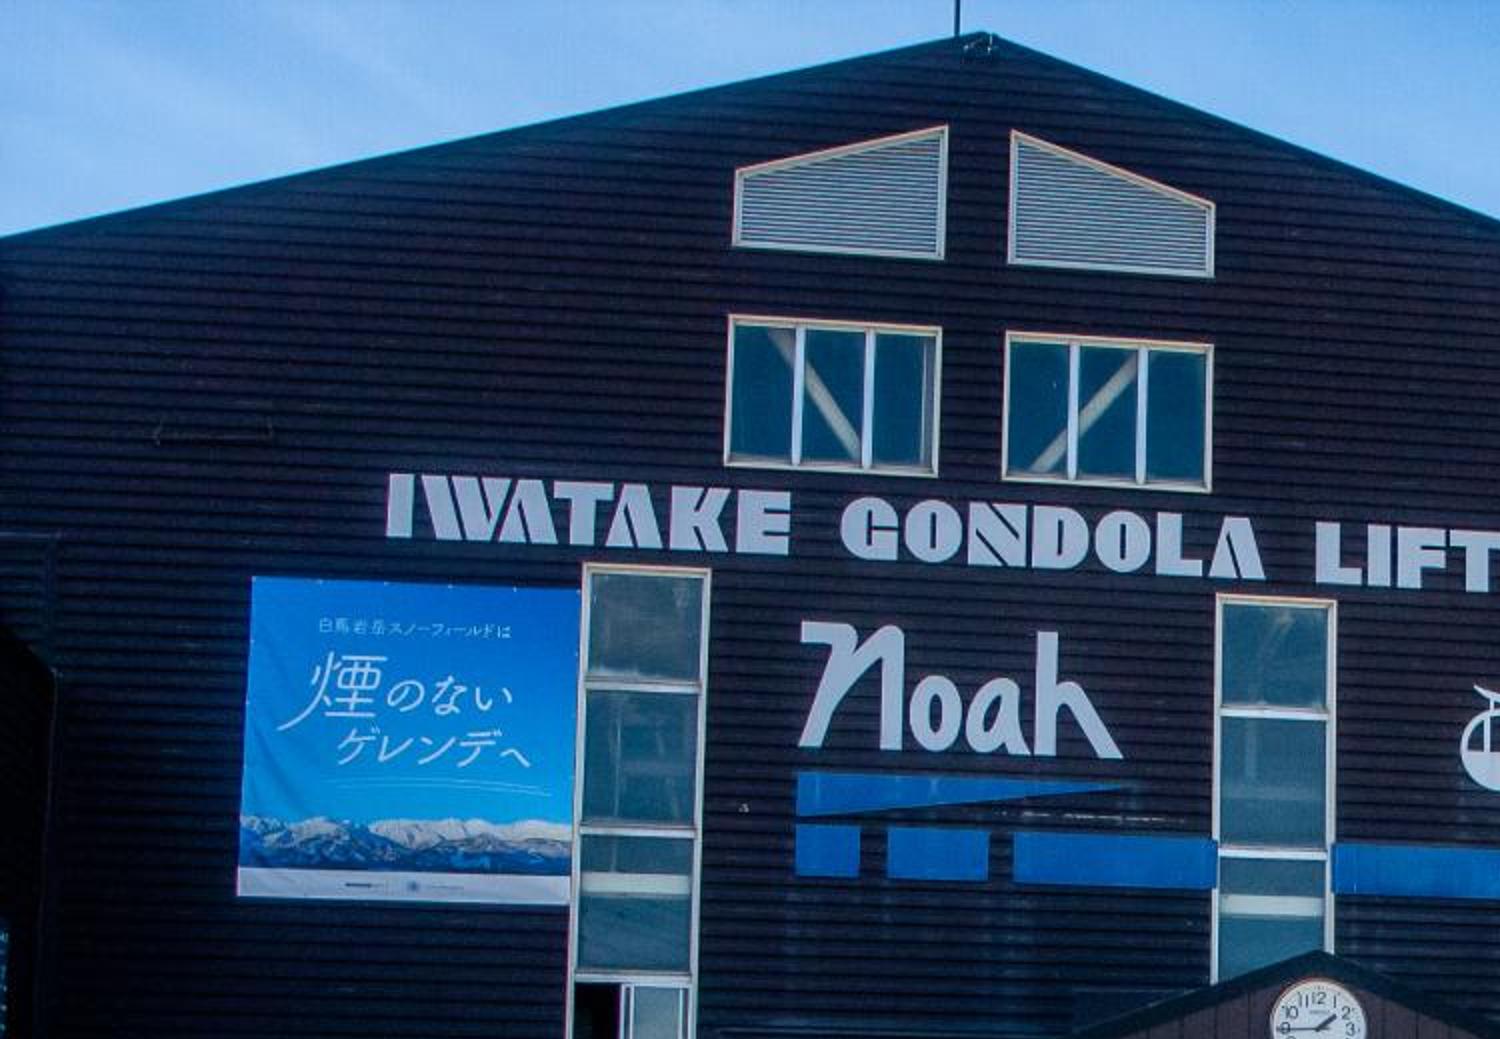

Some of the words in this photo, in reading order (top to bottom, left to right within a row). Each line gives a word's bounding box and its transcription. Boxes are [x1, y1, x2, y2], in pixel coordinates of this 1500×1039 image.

[386, 473, 791, 556] IWATAKE
[841, 497, 1266, 580] GONDOLA
[277, 651, 513, 731] 煙のない
[338, 728, 531, 768] ゲレンデへ
